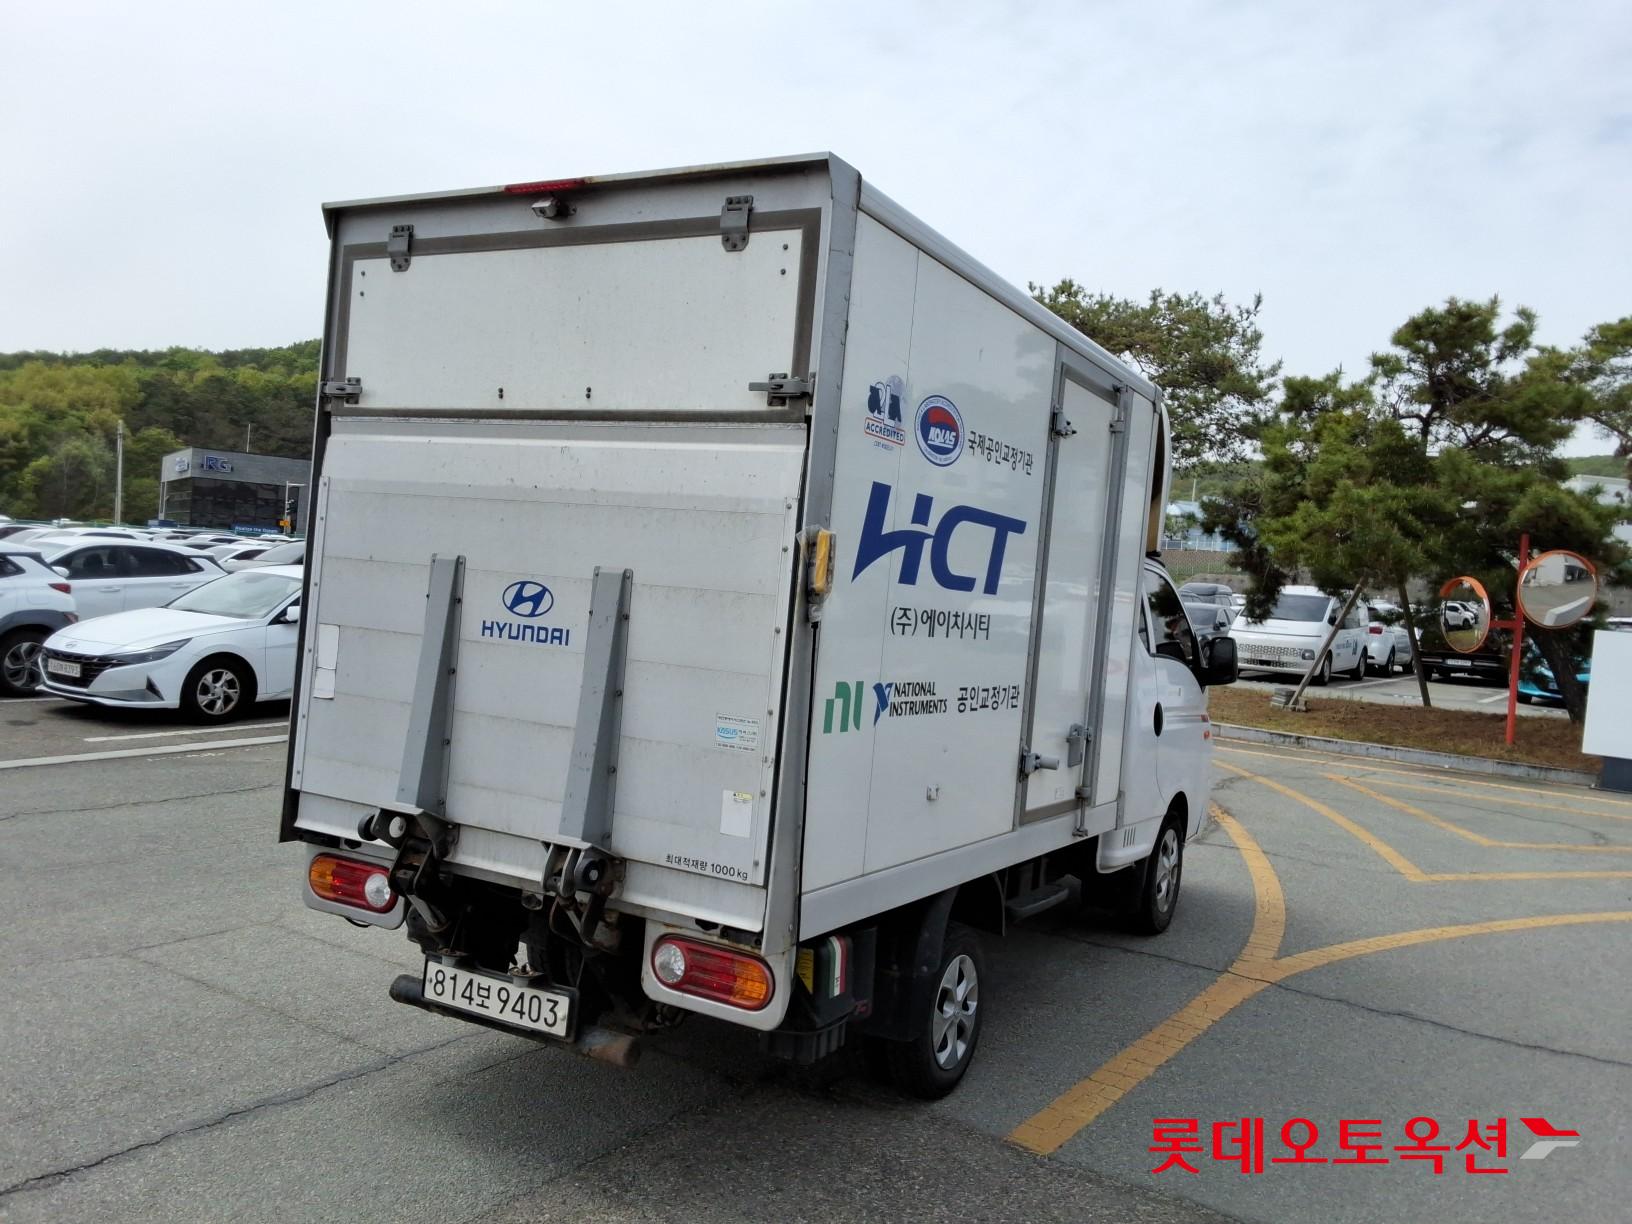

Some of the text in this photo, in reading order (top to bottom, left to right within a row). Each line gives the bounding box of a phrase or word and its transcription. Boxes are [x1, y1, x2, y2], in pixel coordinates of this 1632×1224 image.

[866, 421, 904, 442] ACCREDITED
[928, 426, 956, 447] KOLAS
[968, 430, 1033, 476] 국제공인교정기관
[851, 481, 1027, 596] HCT
[481, 620, 570, 646] HYUNDAI
[893, 682, 936, 698] NATIONAL
[957, 685, 1021, 713] 공인교정기관
[889, 698, 948, 717] INSTRUMENTS
[665, 854, 749, 881] 최대적재량 1000 kg
[433, 969, 560, 1028] 814보9403
